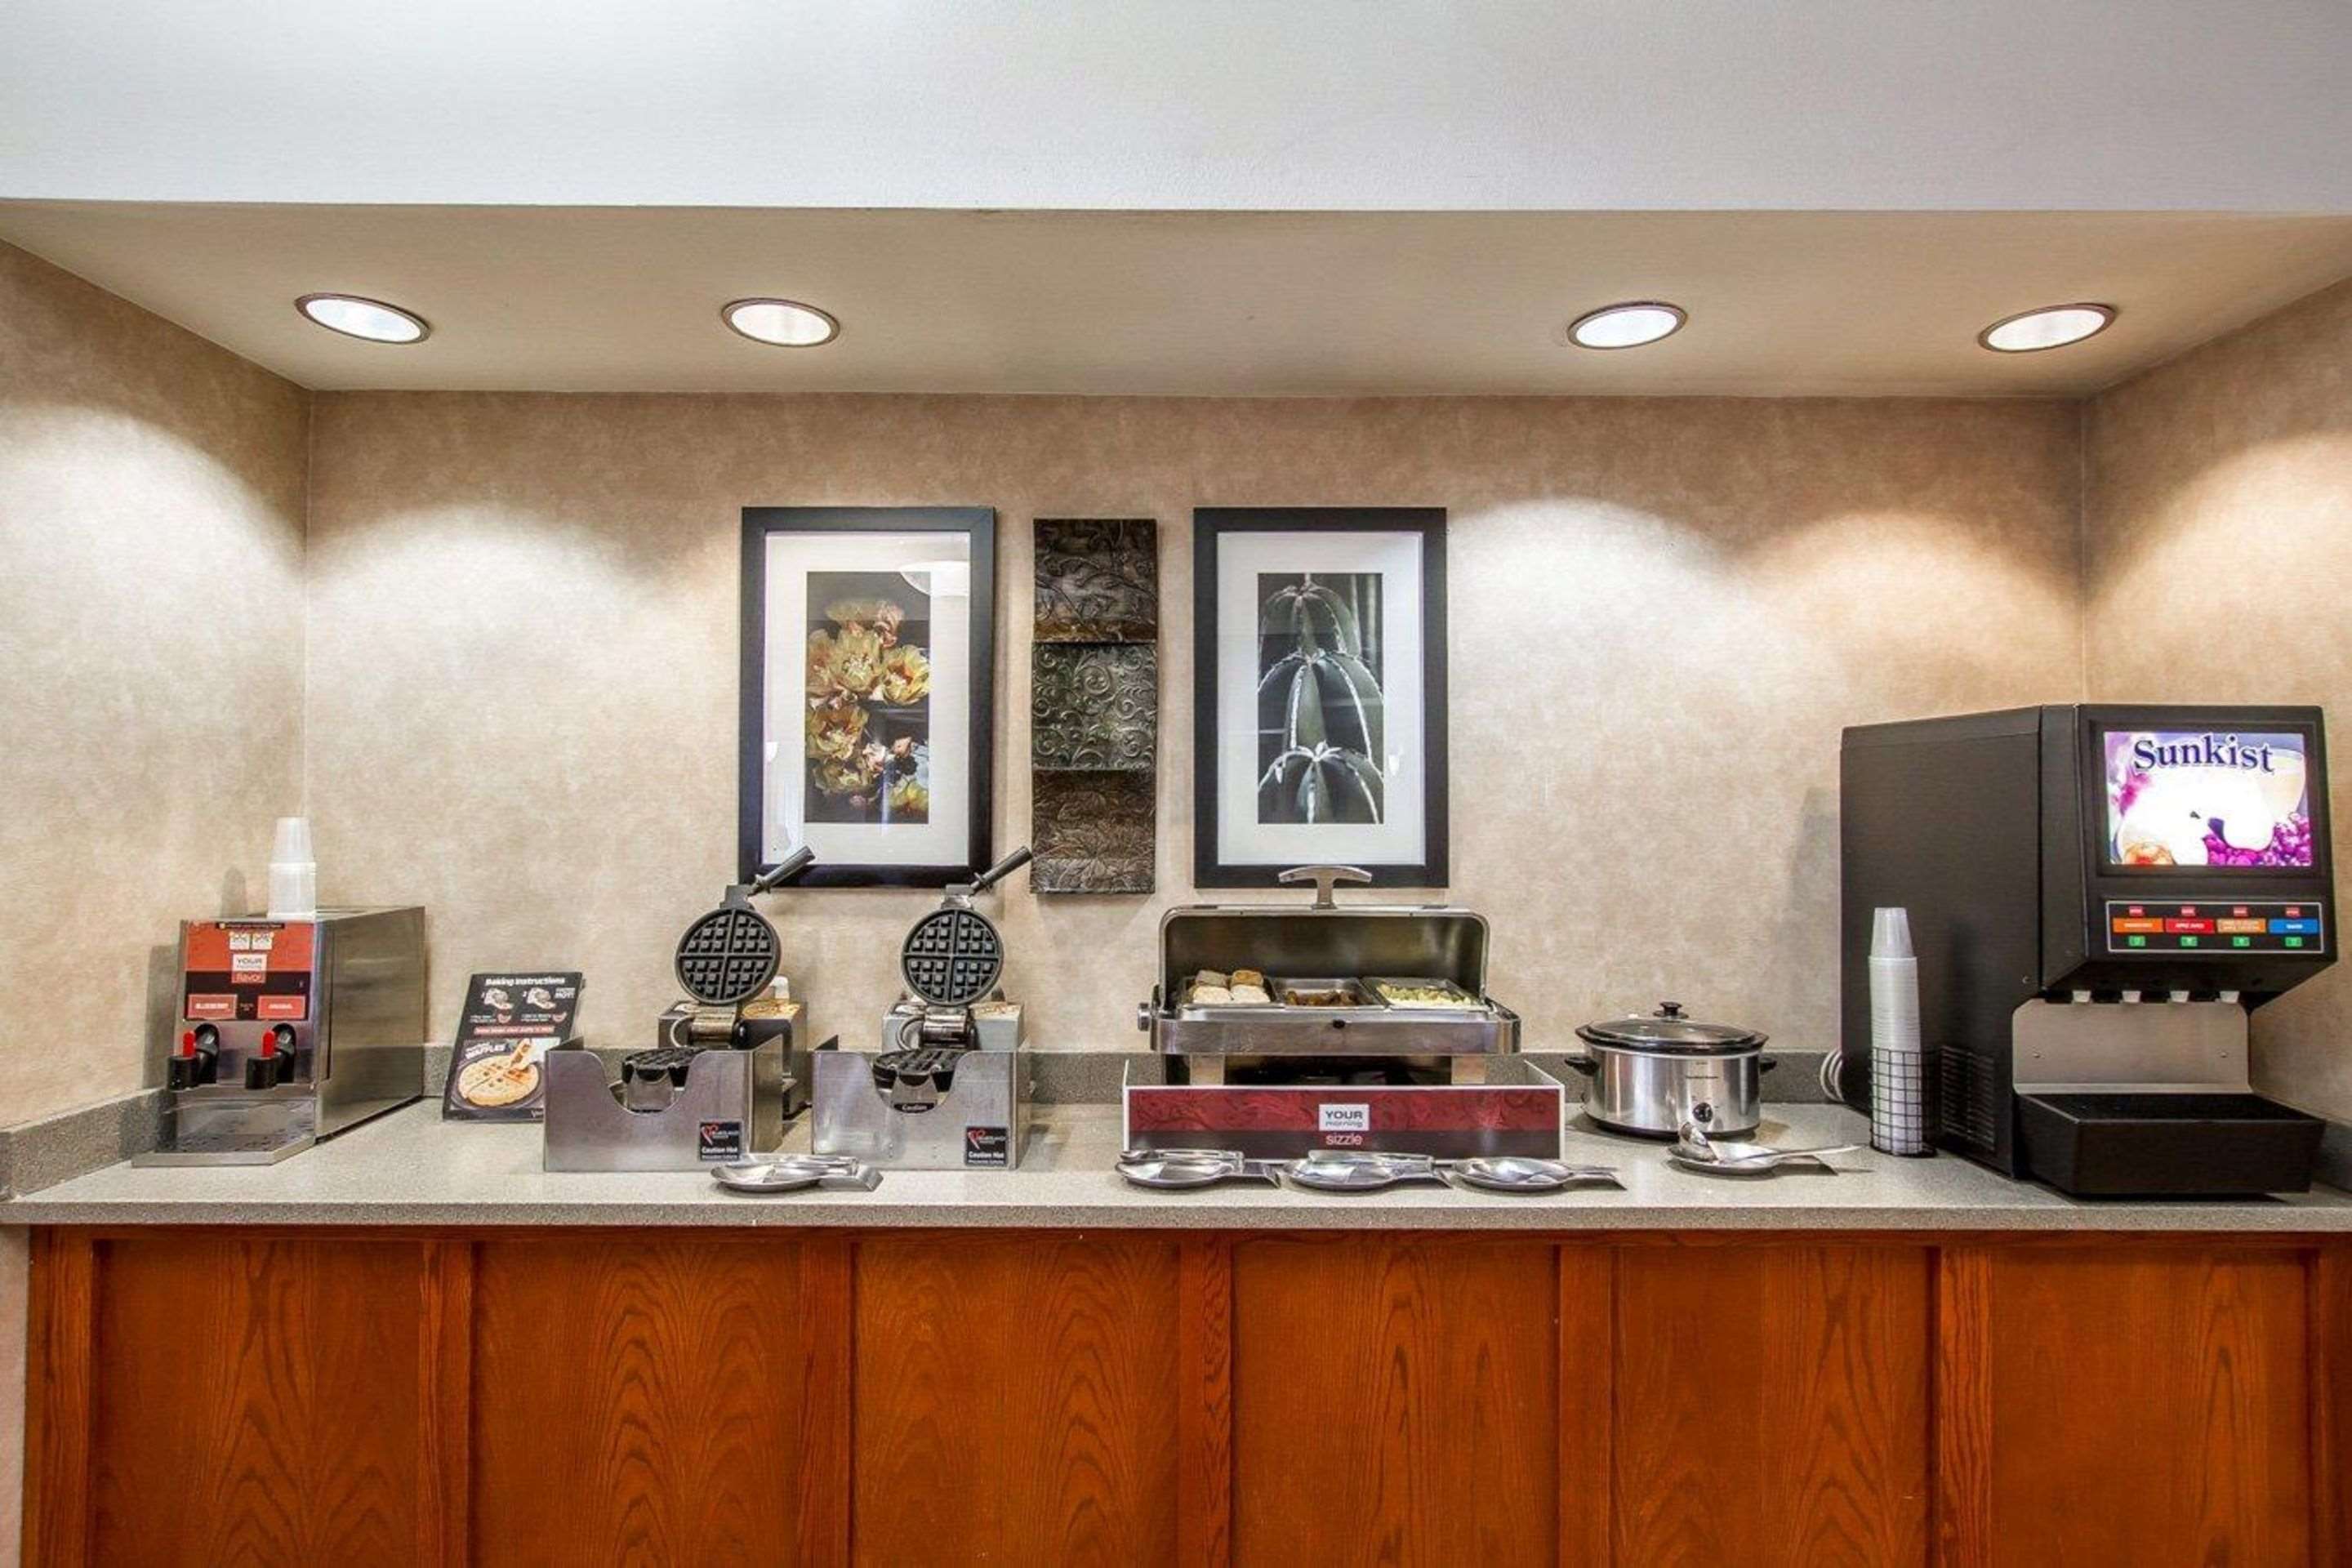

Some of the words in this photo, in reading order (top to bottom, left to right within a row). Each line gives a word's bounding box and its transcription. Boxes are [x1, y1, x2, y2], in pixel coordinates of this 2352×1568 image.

[2133, 734, 2274, 773] Sunkist
[515, 977, 565, 986] Instructions
[1325, 1111, 1363, 1119] YOUR
[1325, 1134, 1363, 1145] sizzle
